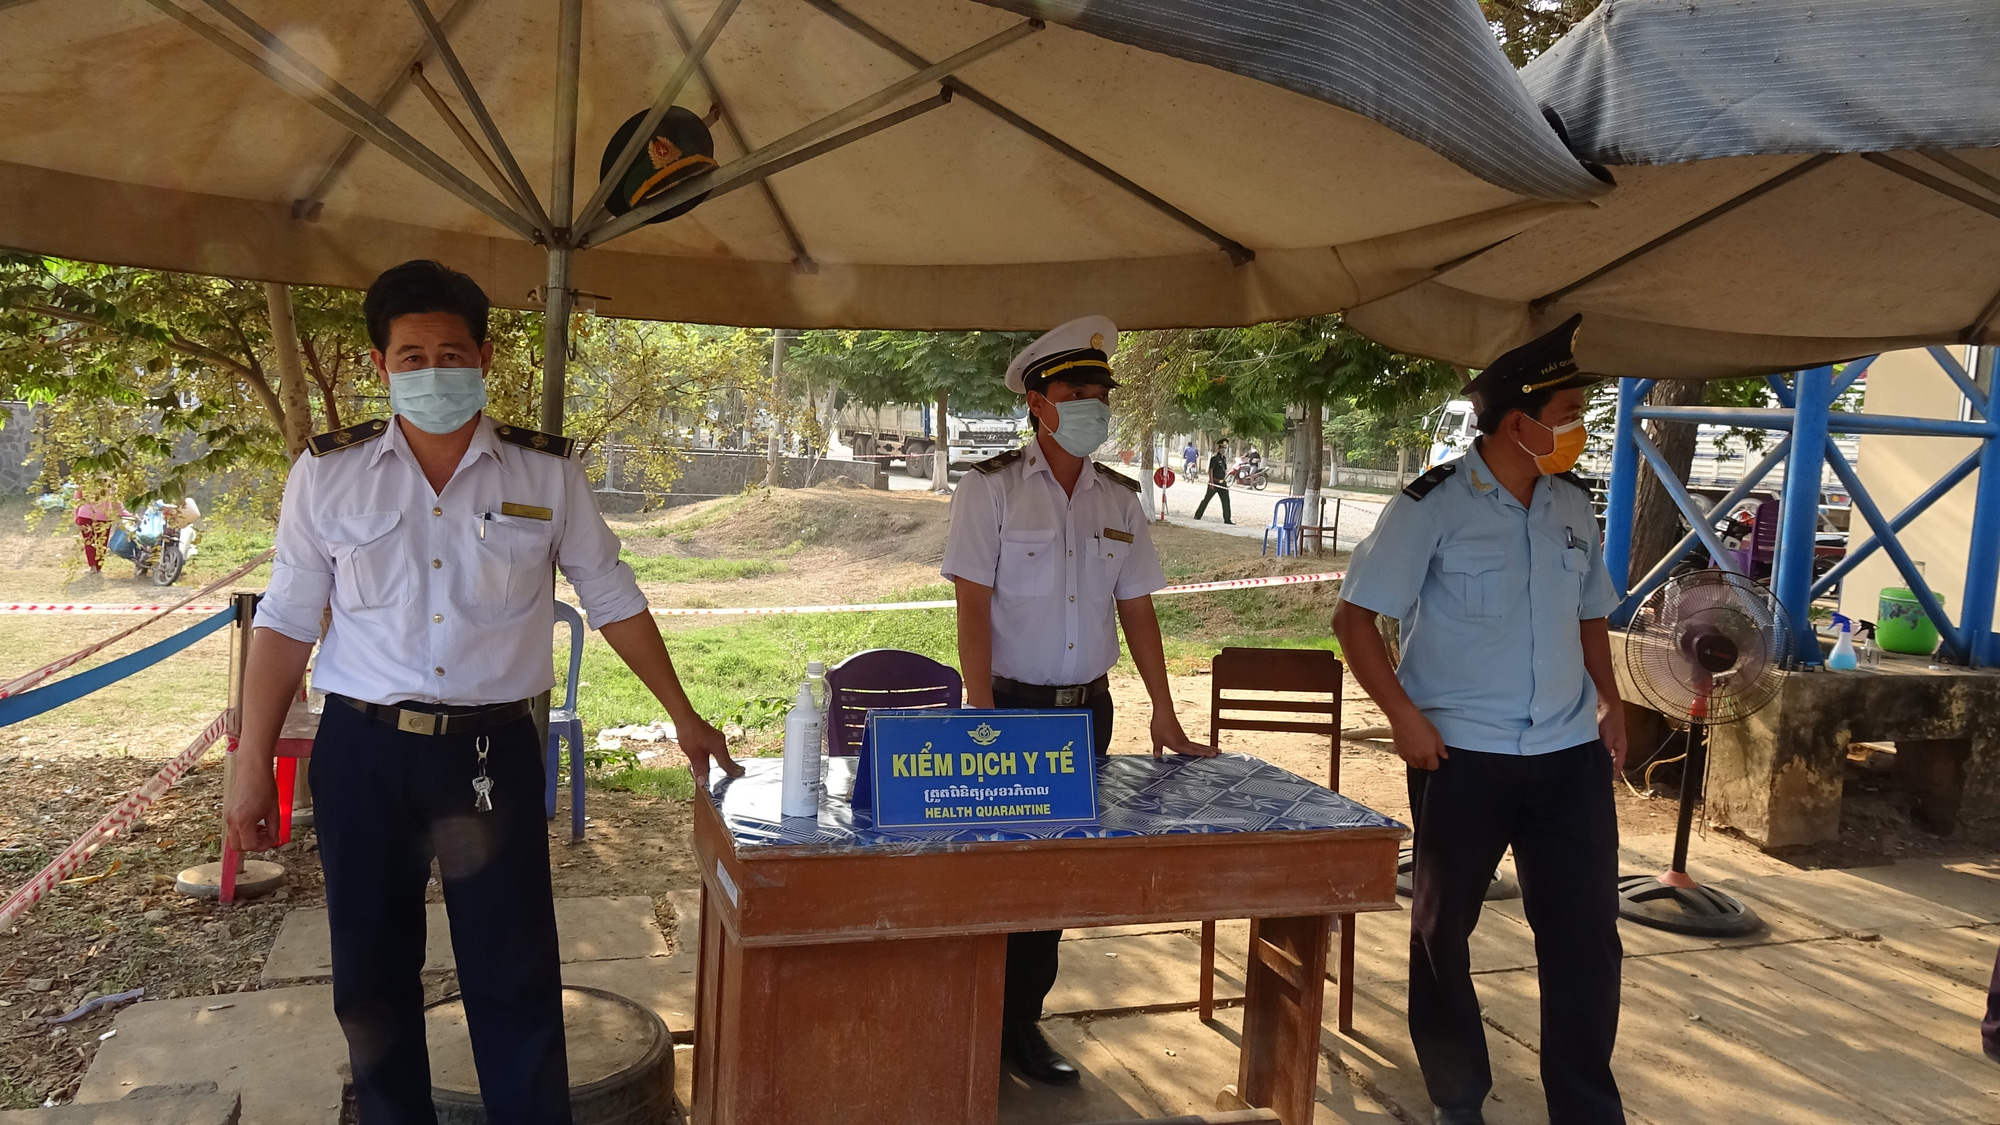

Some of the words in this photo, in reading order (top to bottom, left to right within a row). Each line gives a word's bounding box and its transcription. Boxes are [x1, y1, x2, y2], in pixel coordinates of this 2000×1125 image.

[892, 742, 953, 777] KIỂM
[961, 752, 1017, 783] DỊCH
[1023, 752, 1038, 774] Y
[1046, 741, 1075, 773] TẾ
[925, 807, 973, 819] HEALTH
[976, 804, 1051, 817] QUARANTINE
